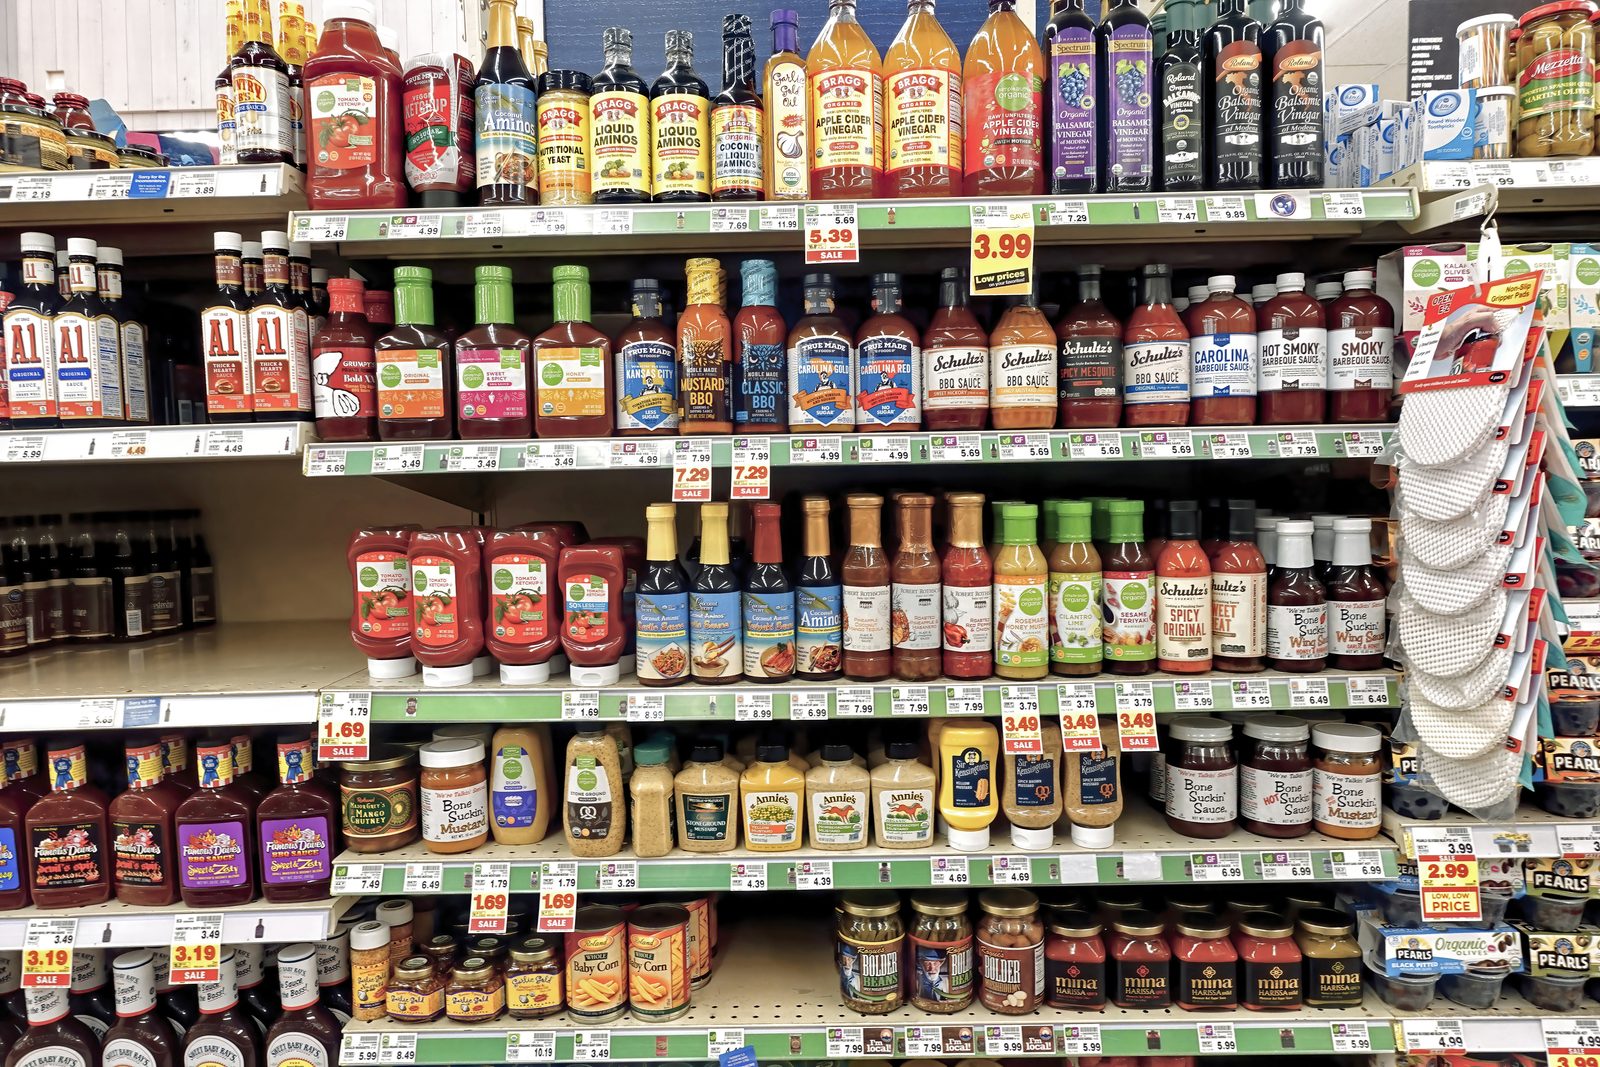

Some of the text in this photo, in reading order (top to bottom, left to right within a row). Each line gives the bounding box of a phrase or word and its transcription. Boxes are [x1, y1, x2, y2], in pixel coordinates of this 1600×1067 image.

[1231, 58, 1255, 69] Roland
[1532, 56, 1585, 77] Mezzetta
[824, 76, 862, 87] BRAGG
[1525, 87, 1590, 105] MARTINI OLIVES
[597, 101, 634, 110] BRAGG
[1275, 96, 1320, 110] Balsamic
[495, 110, 523, 118] Coconut
[1278, 109, 1320, 121] Vinegar
[484, 116, 536, 134] Aminos
[816, 114, 871, 126] APPLE CIDER
[983, 119, 1040, 128] APPLE CIDER
[596, 125, 634, 135] LIQUID
[825, 125, 863, 135] VINEGAR
[1056, 121, 1094, 130] BALSAMIC
[993, 128, 1033, 136] VINEGAR
[594, 136, 638, 145] AMINOS
[548, 156, 571, 164] YEAST
[1343, 207, 1362, 215] 4.39
[325, 230, 344, 238] 2.49
[810, 229, 852, 243] 5.39
[975, 234, 1031, 258] 3.99
[976, 270, 1025, 284] Low prices
[1506, 284, 1532, 293] Non-Slip
[1491, 291, 1529, 303] Gripper Pads
[209, 318, 238, 356] A1
[11, 322, 40, 364] A1
[60, 325, 87, 364] A1
[628, 348, 671, 357] TRUE MADE
[1195, 350, 1249, 363] CAROLINA
[934, 352, 984, 372] Schultz's
[1060, 366, 1116, 379] SPICY MESQUITE
[1195, 362, 1249, 373] BARBEQUE SAUCE
[1007, 375, 1049, 389] BBQ SAUCE
[690, 393, 713, 407] BBQ
[127, 446, 146, 454] 4.49
[224, 444, 242, 452] 4.49
[961, 449, 980, 457] 5.69
[1030, 447, 1049, 455] 5.69
[22, 450, 41, 458] 5.99
[820, 452, 839, 461] 4.99
[326, 464, 344, 472] 5.69
[401, 460, 420, 468] 3.49
[676, 468, 709, 482] 7.29
[1170, 609, 1199, 623] SPICY
[1294, 614, 1319, 626] Bone
[1163, 622, 1206, 636] ORIGINAL
[1194, 698, 1212, 706] 5.99
[1309, 696, 1328, 705] 6.49
[854, 704, 873, 714] 7.99
[1019, 701, 1037, 711] 3.79
[349, 708, 368, 716] 1.79
[581, 708, 598, 717] 1.69
[644, 711, 663, 719] 8.99
[753, 710, 771, 718] 8.99
[808, 709, 826, 717] 6.99
[1005, 716, 1038, 732] 3.49
[325, 722, 364, 738] 1.69
[1014, 741, 1033, 749] SALE
[332, 747, 355, 755] SALE
[1275, 781, 1302, 793] Bone
[756, 794, 789, 805] Annie's
[823, 794, 857, 805] Annie's
[442, 800, 472, 812] Bone
[1328, 807, 1377, 820] Mustard
[35, 844, 97, 857] Famous Dave's
[1448, 843, 1473, 854] 3.99
[1011, 872, 1030, 881] 4.69
[1222, 868, 1241, 877] 6.99
[1428, 864, 1469, 879] 2.99
[617, 879, 635, 887] 3.29
[813, 877, 831, 886] 4.39
[949, 874, 967, 882] 4.69
[1535, 874, 1588, 891] PEARLS
[361, 881, 380, 889] 7.49
[422, 881, 440, 889] 6.49
[490, 879, 508, 888] 1.79
[747, 879, 765, 888] 4.39
[474, 894, 506, 910] 1.69
[1433, 902, 1471, 912] PRICE
[54, 935, 73, 944] 3.49
[201, 930, 220, 939] 3.49
[1435, 937, 1487, 952] Organic
[27, 950, 68, 965] 3.19
[634, 951, 654, 960] WHOLE
[644, 962, 667, 971] Corn
[862, 951, 897, 977] BOLDER
[36, 975, 57, 984] SALE
[1056, 977, 1097, 989] mina
[1191, 978, 1232, 990] mina
[1083, 1041, 1101, 1051] 5.99
[1217, 1040, 1235, 1050] 5.99
[1438, 1036, 1463, 1047] 4.99
[845, 1044, 863, 1053] 7.99
[867, 1043, 891, 1053] local!
[1003, 1042, 1022, 1052] 9.99
[358, 1051, 376, 1061] 5.99
[396, 1051, 414, 1060] 8.49
[591, 1049, 609, 1058] 3.49
